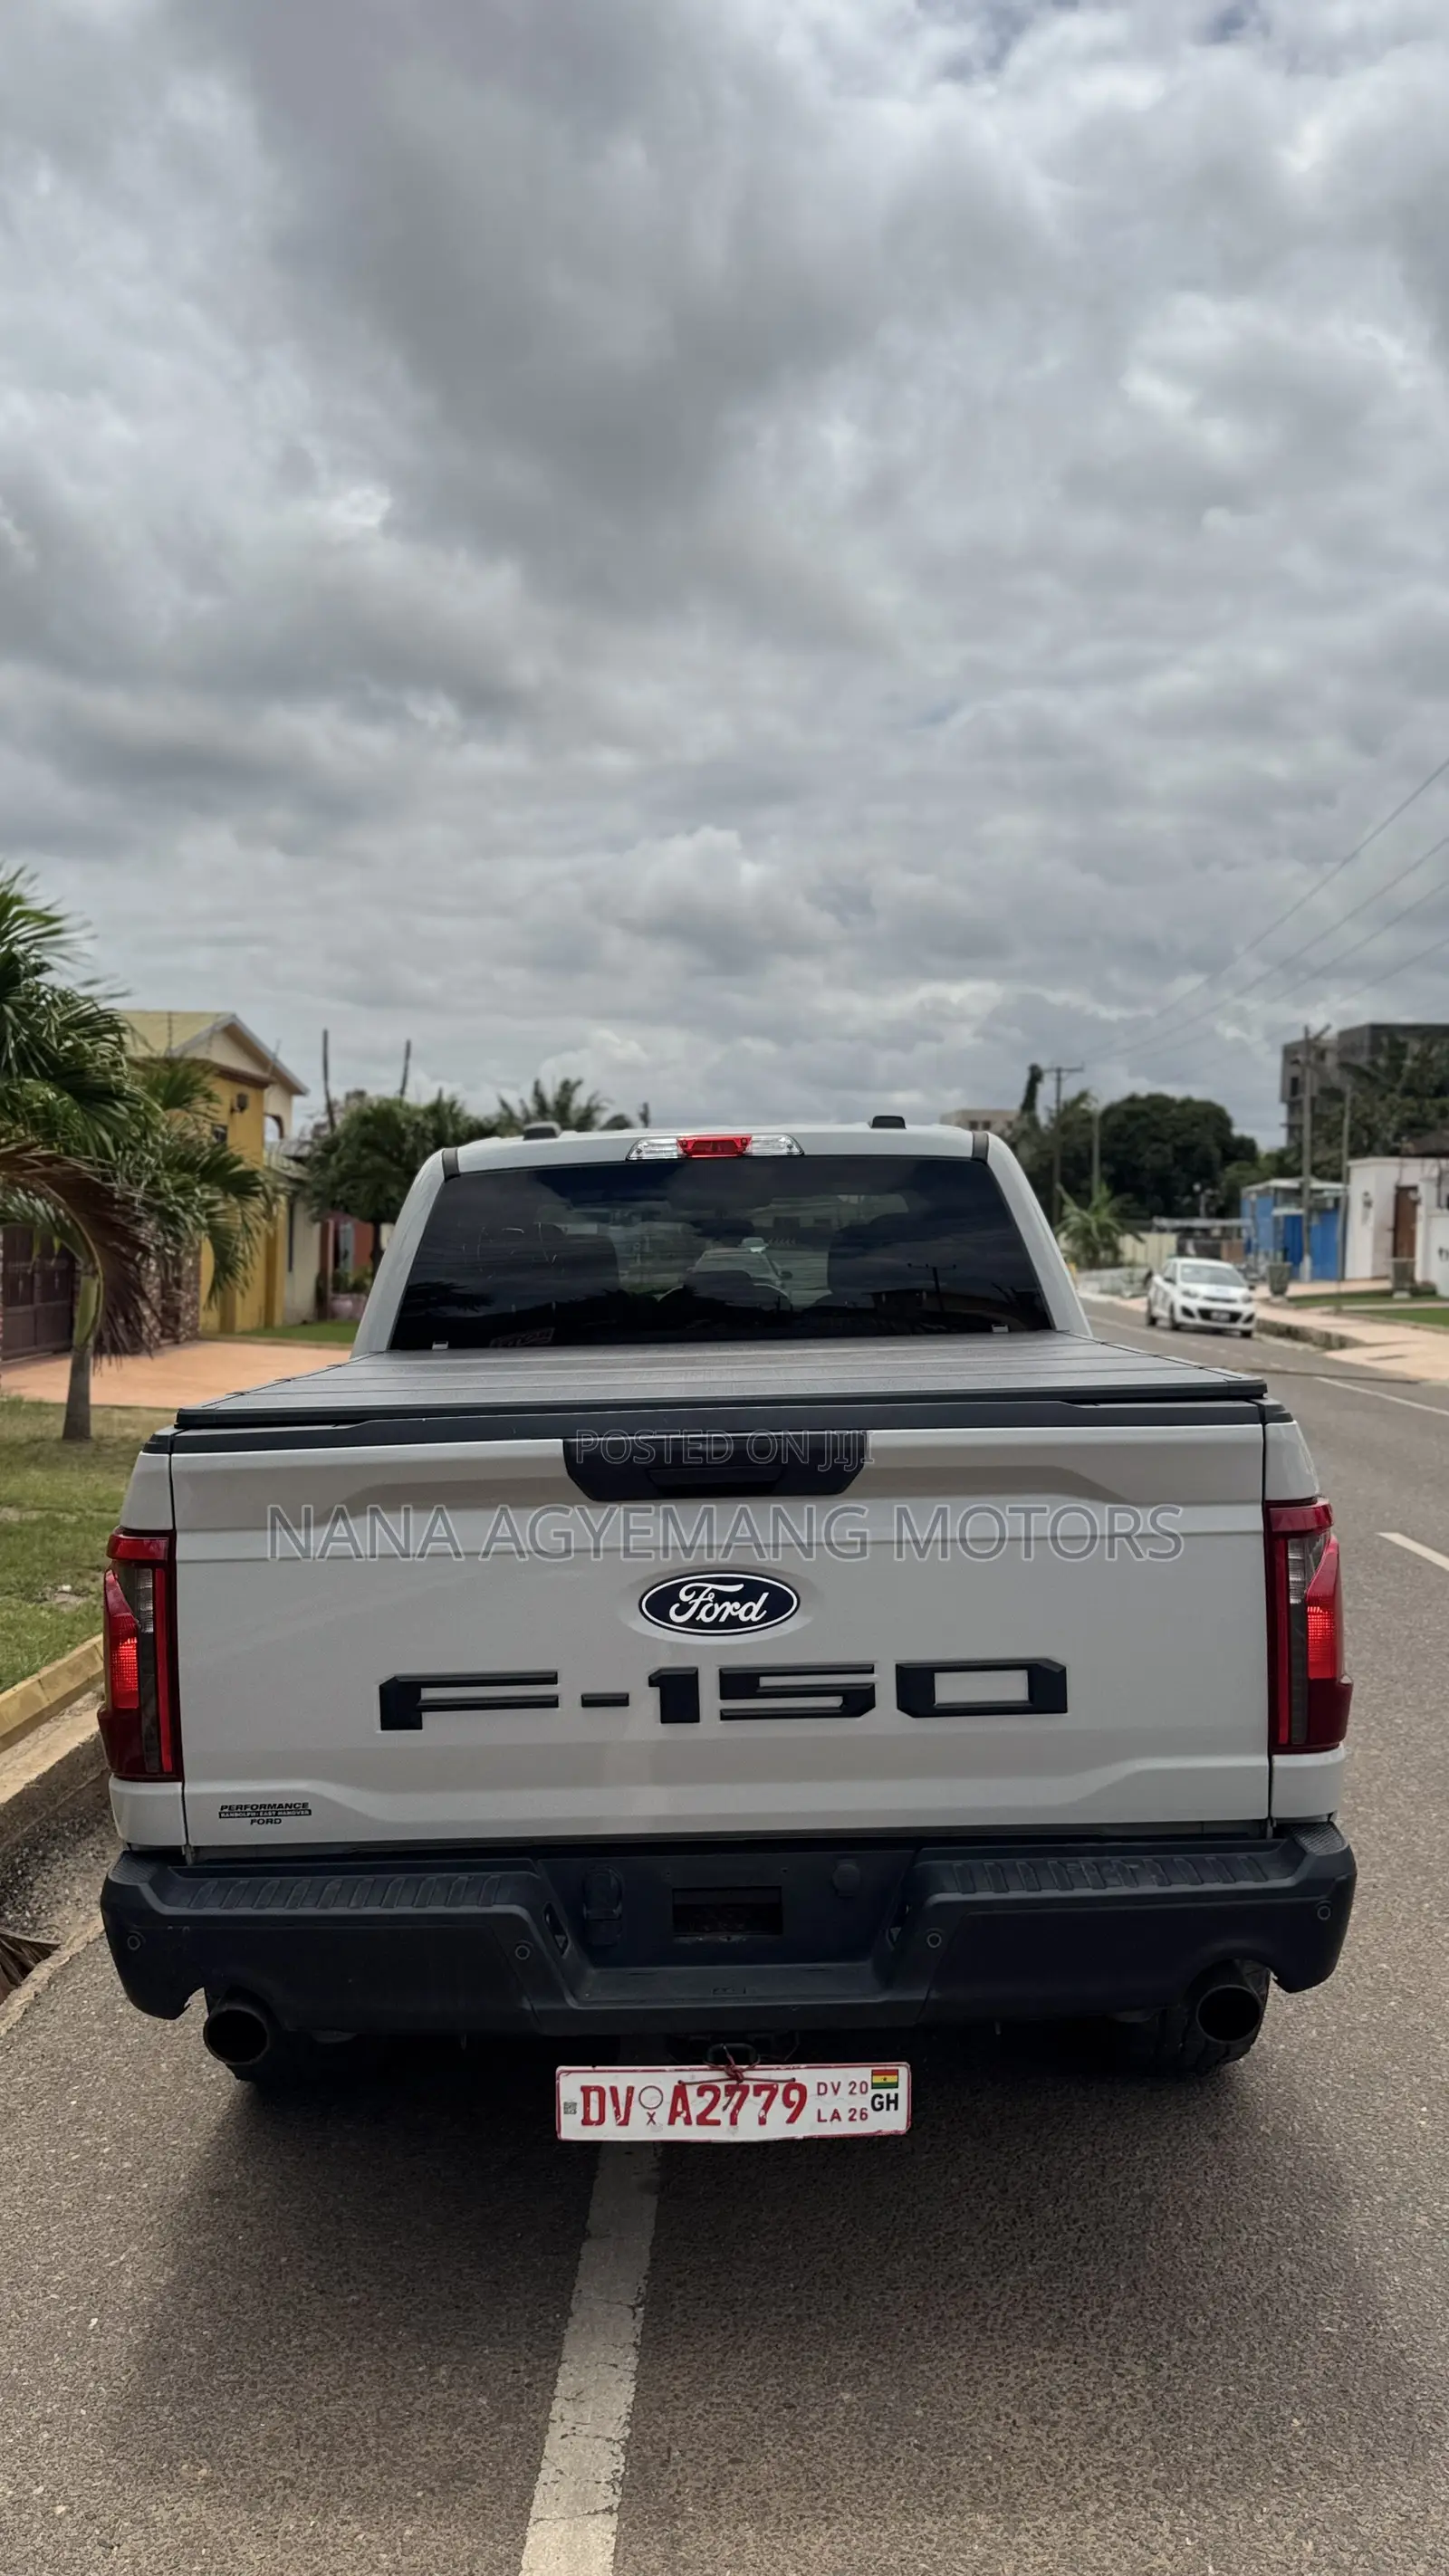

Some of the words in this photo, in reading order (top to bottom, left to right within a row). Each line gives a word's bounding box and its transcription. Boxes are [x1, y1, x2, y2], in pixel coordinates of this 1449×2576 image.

[669, 1583, 770, 1623] Ford
[378, 1657, 1068, 1731] F-150
[220, 1803, 310, 1811] PERFORMANCE
[817, 2081, 840, 2096] DV
[849, 2080, 868, 2095] 20
[581, 2084, 635, 2127] DV
[667, 2083, 808, 2127] A2779
[870, 2093, 898, 2112] GH
[817, 2108, 841, 2123] LA
[849, 2106, 868, 2121] 26
